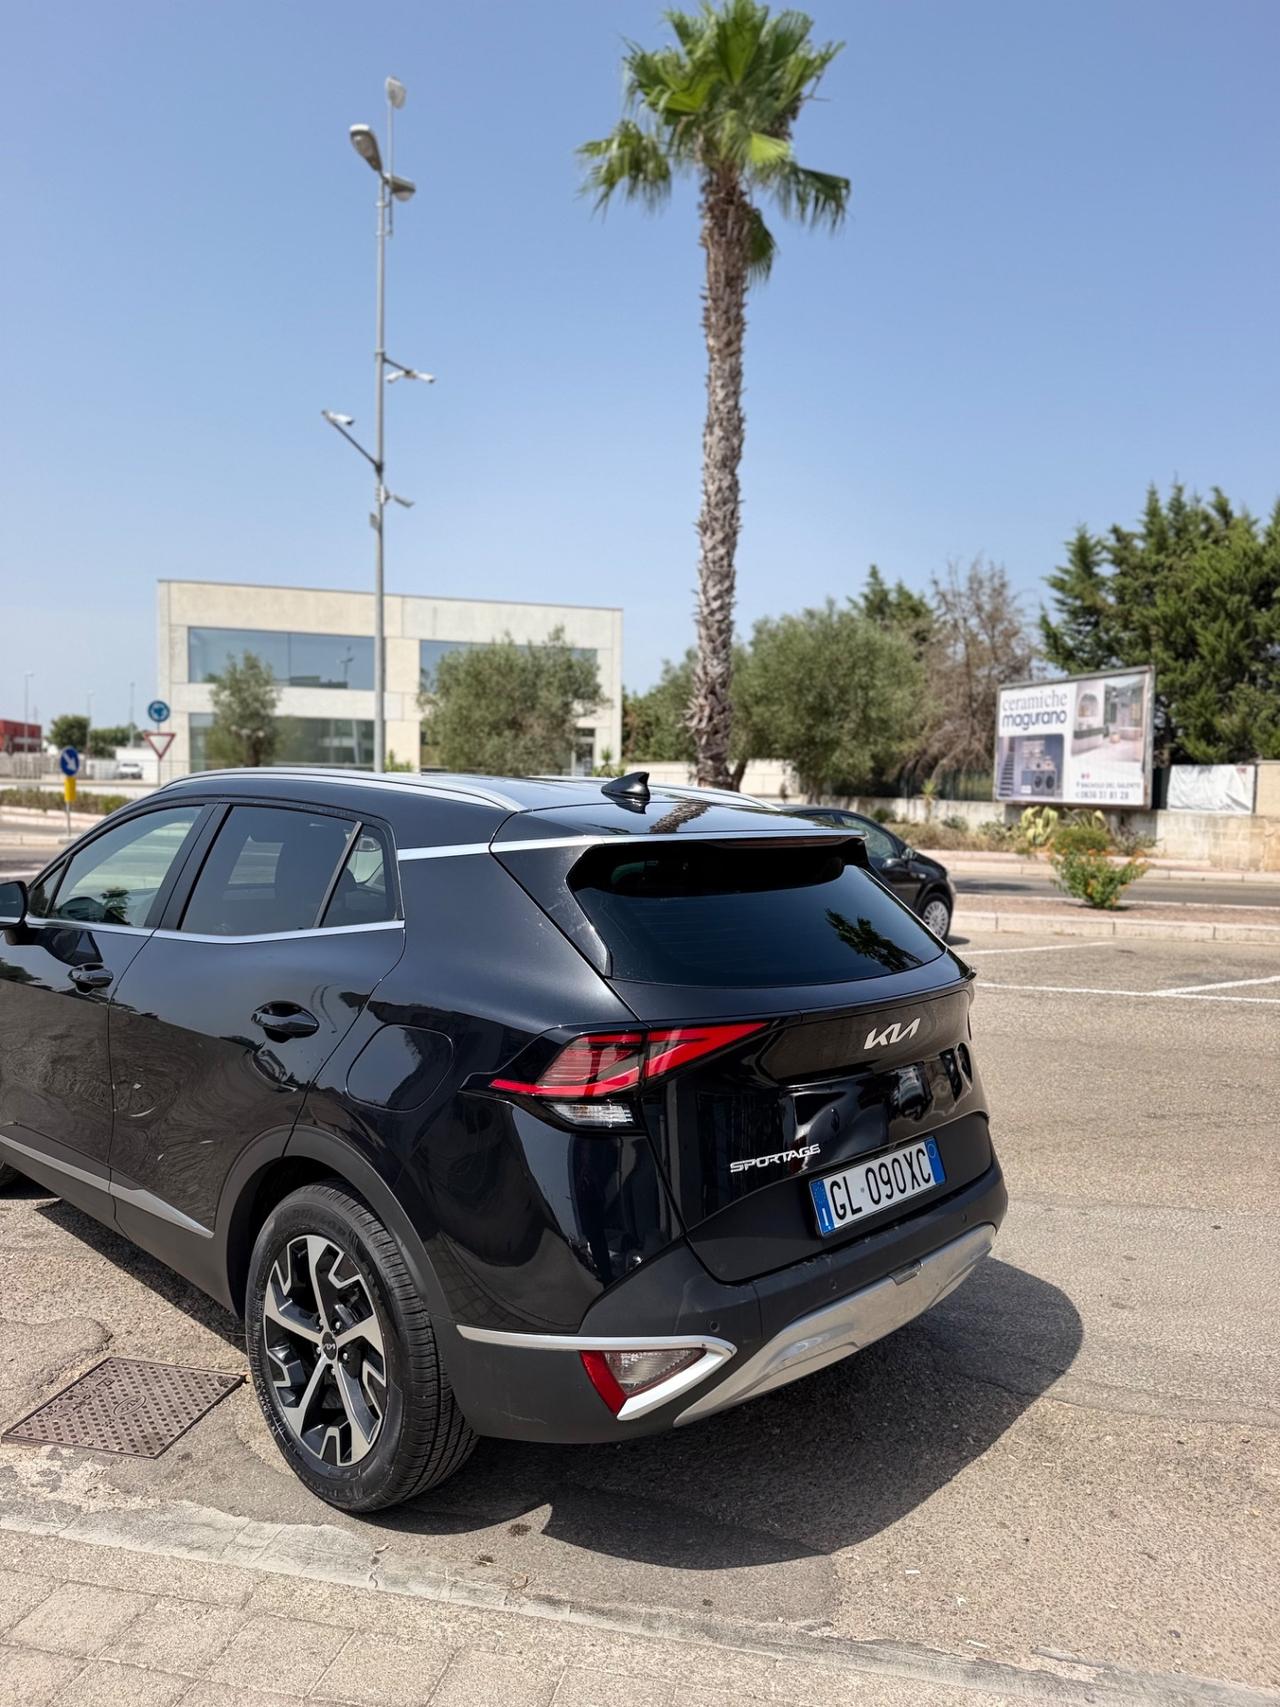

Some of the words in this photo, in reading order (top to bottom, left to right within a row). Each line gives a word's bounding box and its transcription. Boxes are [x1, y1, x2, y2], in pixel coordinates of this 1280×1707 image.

[1002, 688, 1068, 711] ceramiche
[864, 1017, 921, 1050] KIA
[730, 1143, 821, 1173] SPORTAGE
